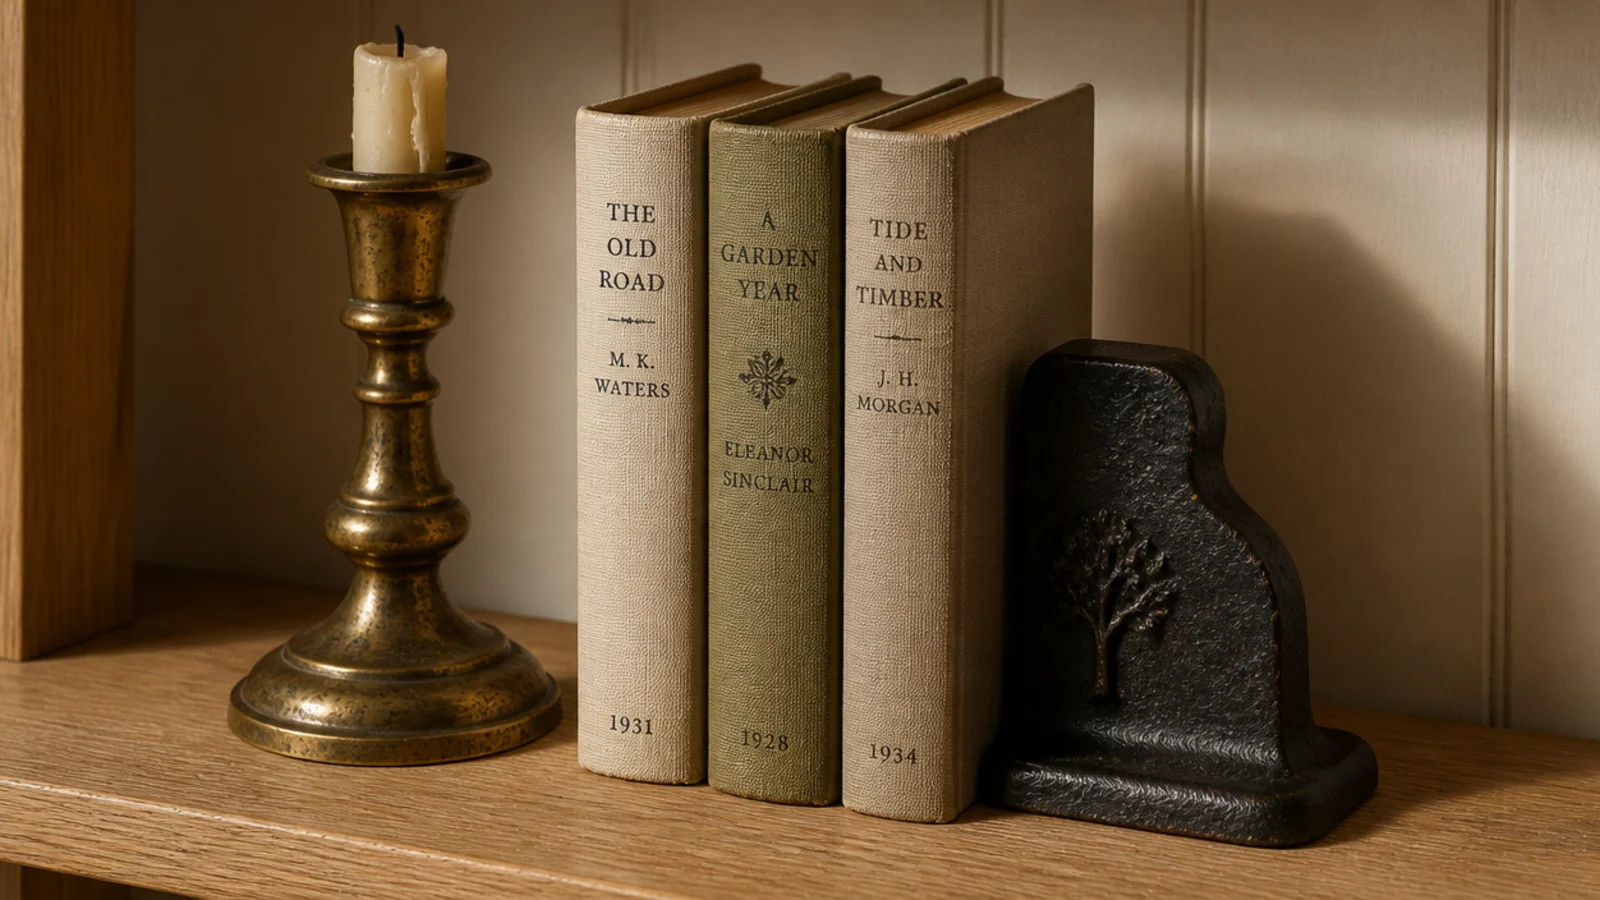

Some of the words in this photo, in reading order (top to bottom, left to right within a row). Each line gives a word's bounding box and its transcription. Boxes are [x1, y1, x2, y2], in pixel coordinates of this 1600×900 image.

[607, 202, 656, 224] THE
[761, 210, 776, 231] A
[869, 218, 928, 240] TIDE
[607, 237, 657, 258] OLD
[721, 243, 819, 268] GARDEN
[874, 253, 922, 273] AND
[599, 269, 665, 292] ROAD
[738, 278, 800, 302] YEAR
[855, 285, 944, 309] TIMBER
[609, 351, 630, 368] M.
[636, 353, 655, 369] K.
[594, 377, 671, 398] WATERS
[877, 369, 890, 388] J.
[898, 370, 919, 387] H.
[856, 394, 940, 416] MORGAN
[724, 440, 814, 464] ELEANOR
[723, 470, 814, 494] SINCLAIR
[609, 714, 653, 736] 1931
[741, 729, 789, 751] 1928
[869, 743, 918, 765] 1934
